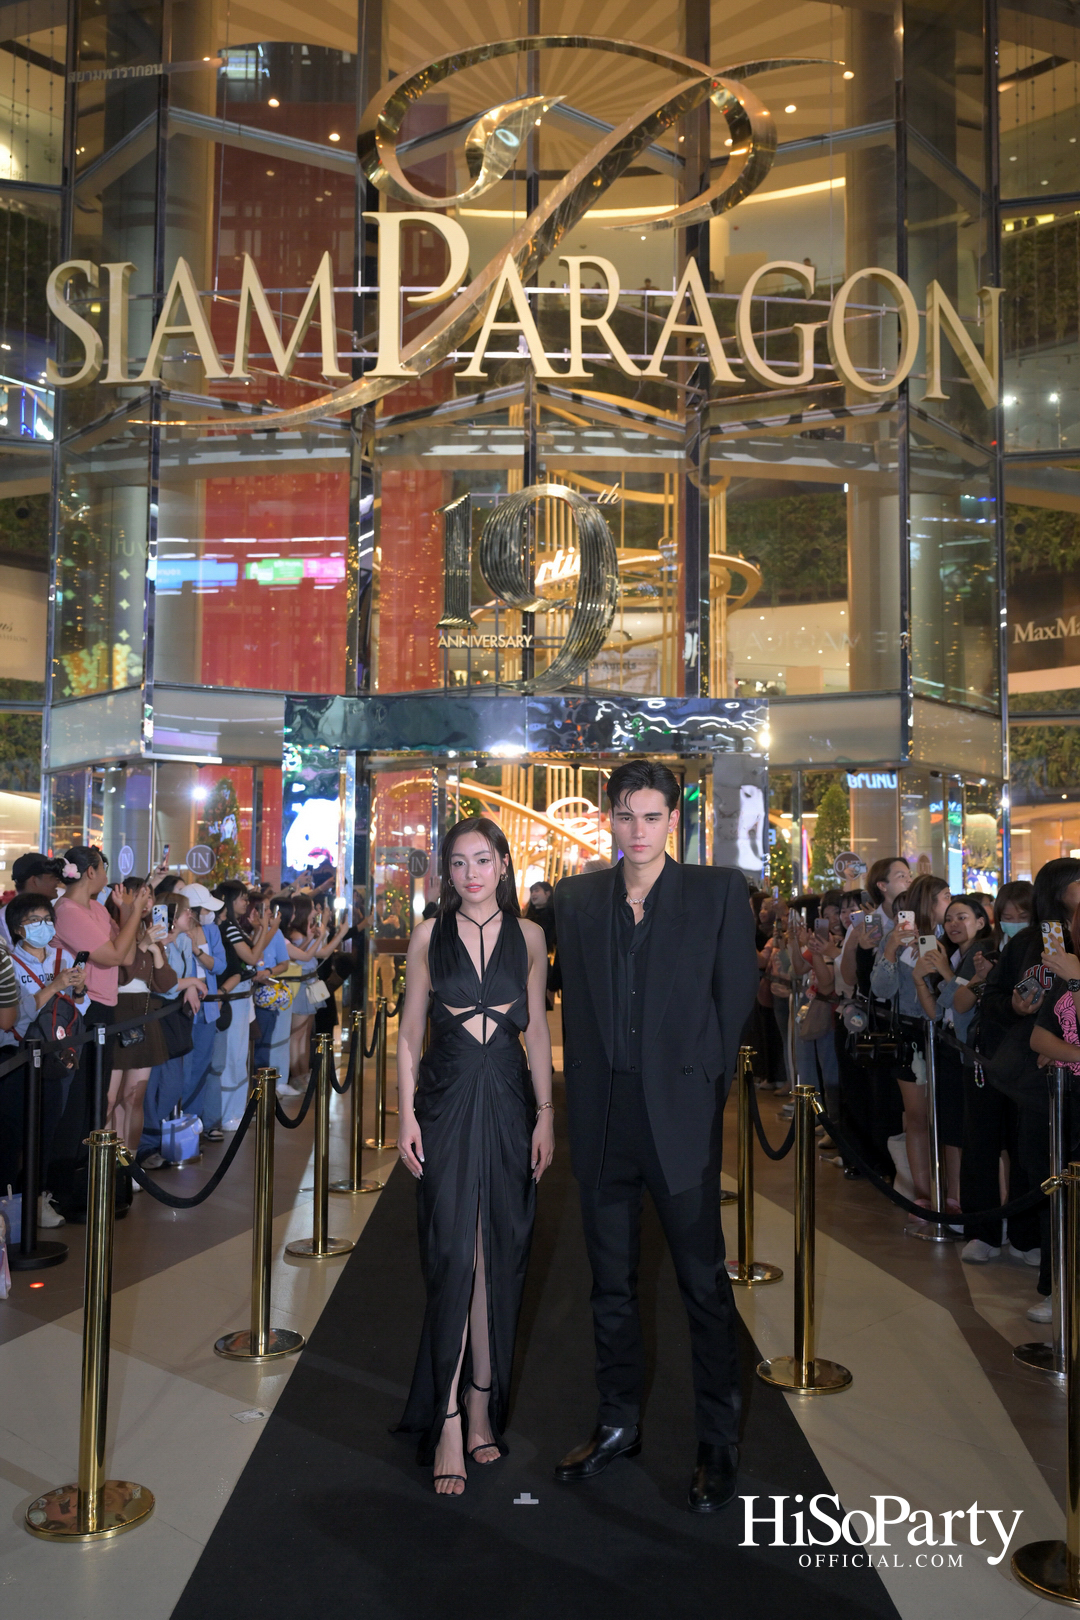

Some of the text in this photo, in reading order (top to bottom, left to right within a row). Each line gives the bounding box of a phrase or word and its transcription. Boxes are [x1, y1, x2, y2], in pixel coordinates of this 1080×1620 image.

[67, 64, 163, 83] สยามพารากอน
[46, 211, 1006, 411] SIAM PARAGON
[437, 634, 533, 648] ANNIVERSARY
[192, 852, 210, 869] IN
[411, 856, 425, 872] IN
